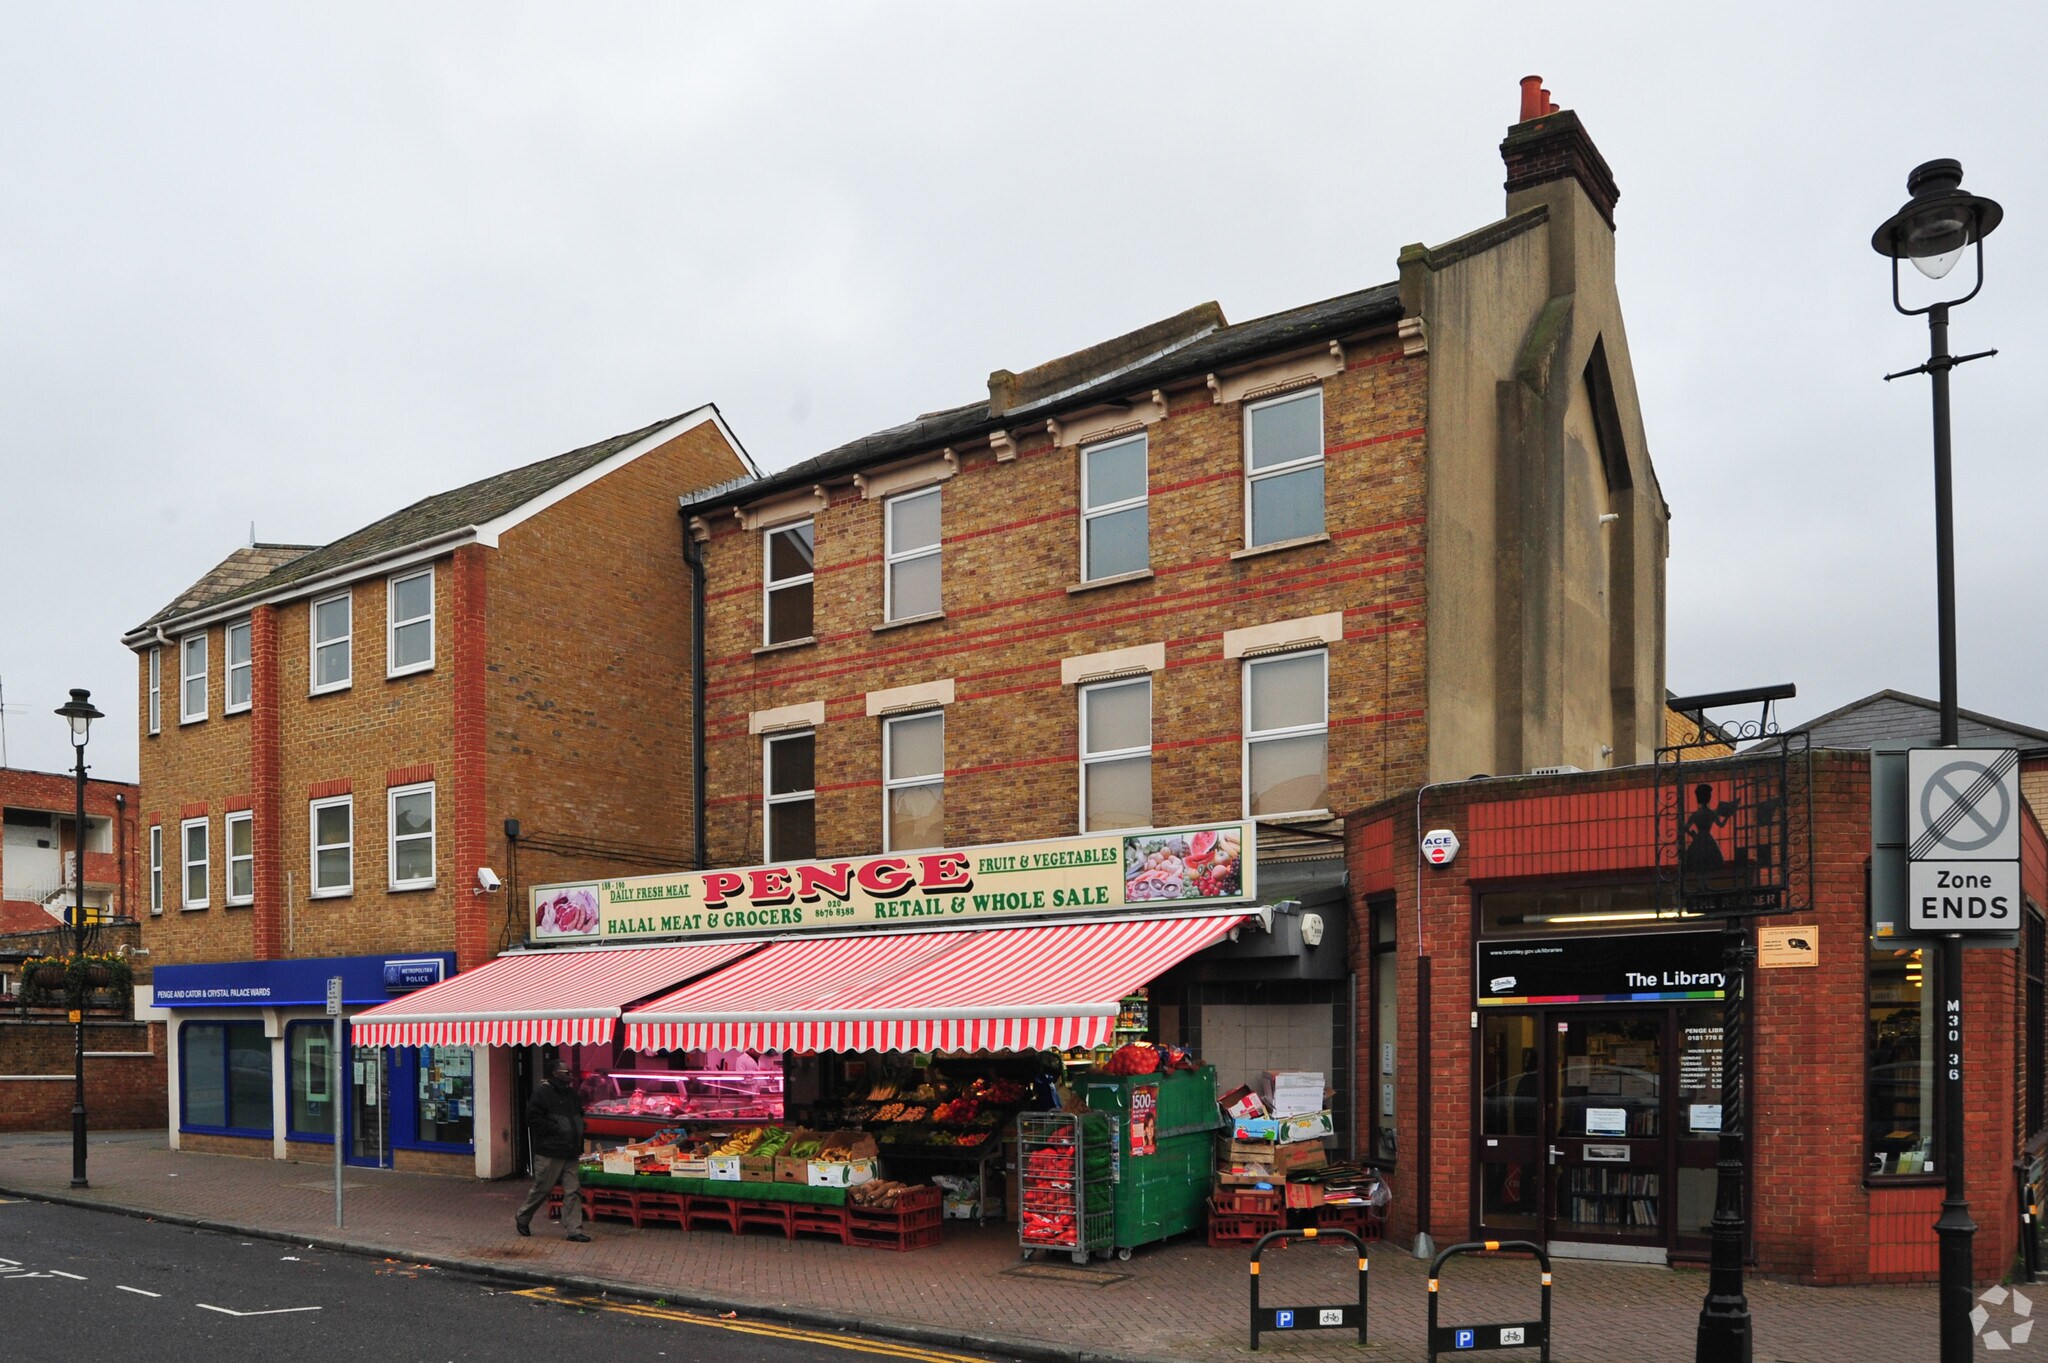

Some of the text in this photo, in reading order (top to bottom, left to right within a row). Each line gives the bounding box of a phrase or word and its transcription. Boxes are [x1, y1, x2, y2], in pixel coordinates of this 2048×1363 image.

[1424, 837, 1452, 846] ACE
[979, 847, 1118, 872] FRUIT & VEGETABLES
[602, 881, 611, 891] 188
[616, 881, 625, 890] 190
[701, 852, 973, 909] PENGE
[1937, 870, 1992, 888] Zone
[610, 884, 690, 901] DAILY FRESH MEAT
[827, 900, 842, 908] 020
[874, 886, 1110, 919] RETAIL & WHOLE SALE
[1922, 896, 2009, 919] ENDS
[815, 906, 855, 918] 8676 8388
[608, 907, 803, 934] HALAL MEAT & GROCERS
[1490, 948, 1563, 956] www.bromley.gov.uk/libraries
[406, 975, 429, 983] POLICE
[1625, 971, 1726, 988] The Library
[157, 990, 173, 999] PENGE
[174, 990, 184, 998] AND
[185, 990, 201, 998] CATOR
[207, 989, 229, 998] CRYSTAL
[230, 988, 250, 997] PALACE
[250, 988, 271, 997] WARDS
[1132, 1094, 1151, 1108] 1500
[1280, 1312, 1290, 1326] P
[1460, 1332, 1471, 1346] P
